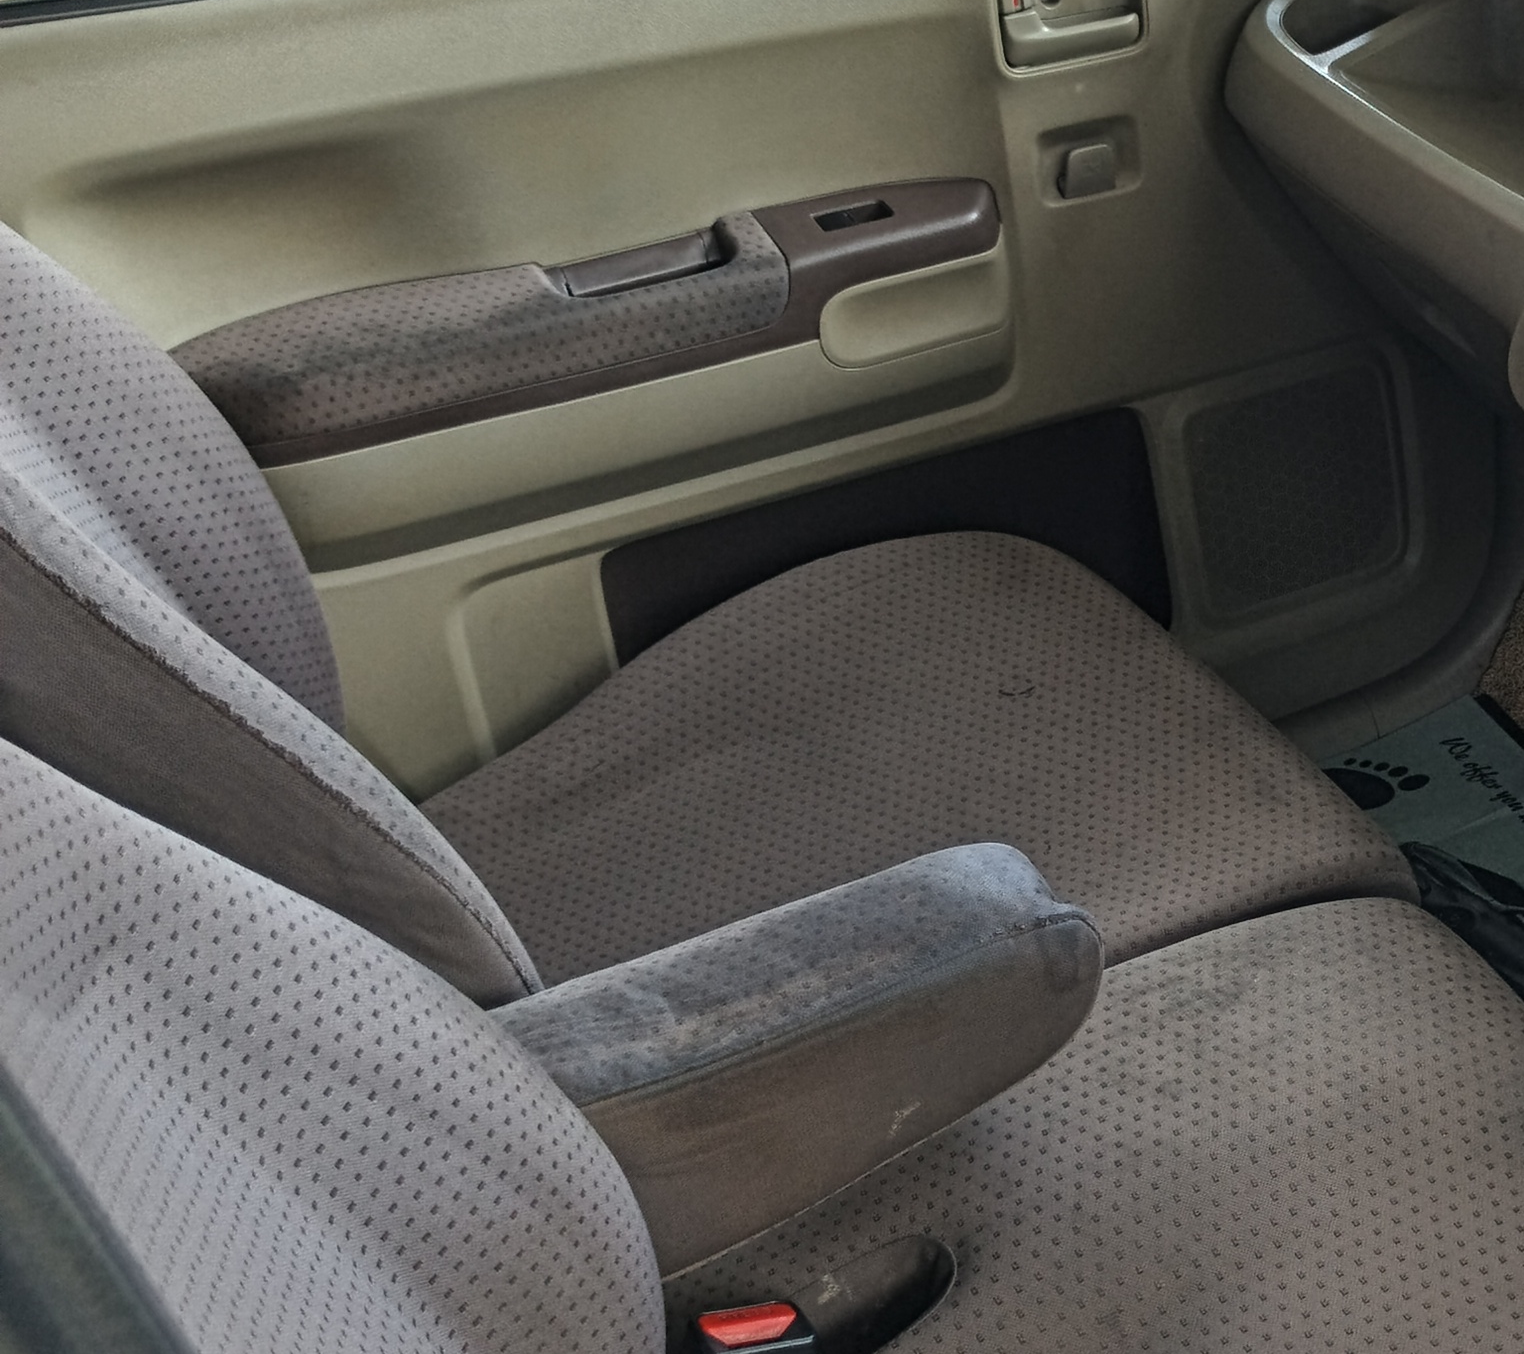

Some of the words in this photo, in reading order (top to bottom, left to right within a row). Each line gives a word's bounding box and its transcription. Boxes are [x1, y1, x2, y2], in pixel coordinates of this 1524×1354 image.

[1440, 737, 1473, 762] We
[1461, 759, 1501, 791] offer
[1489, 790, 1524, 813] you
